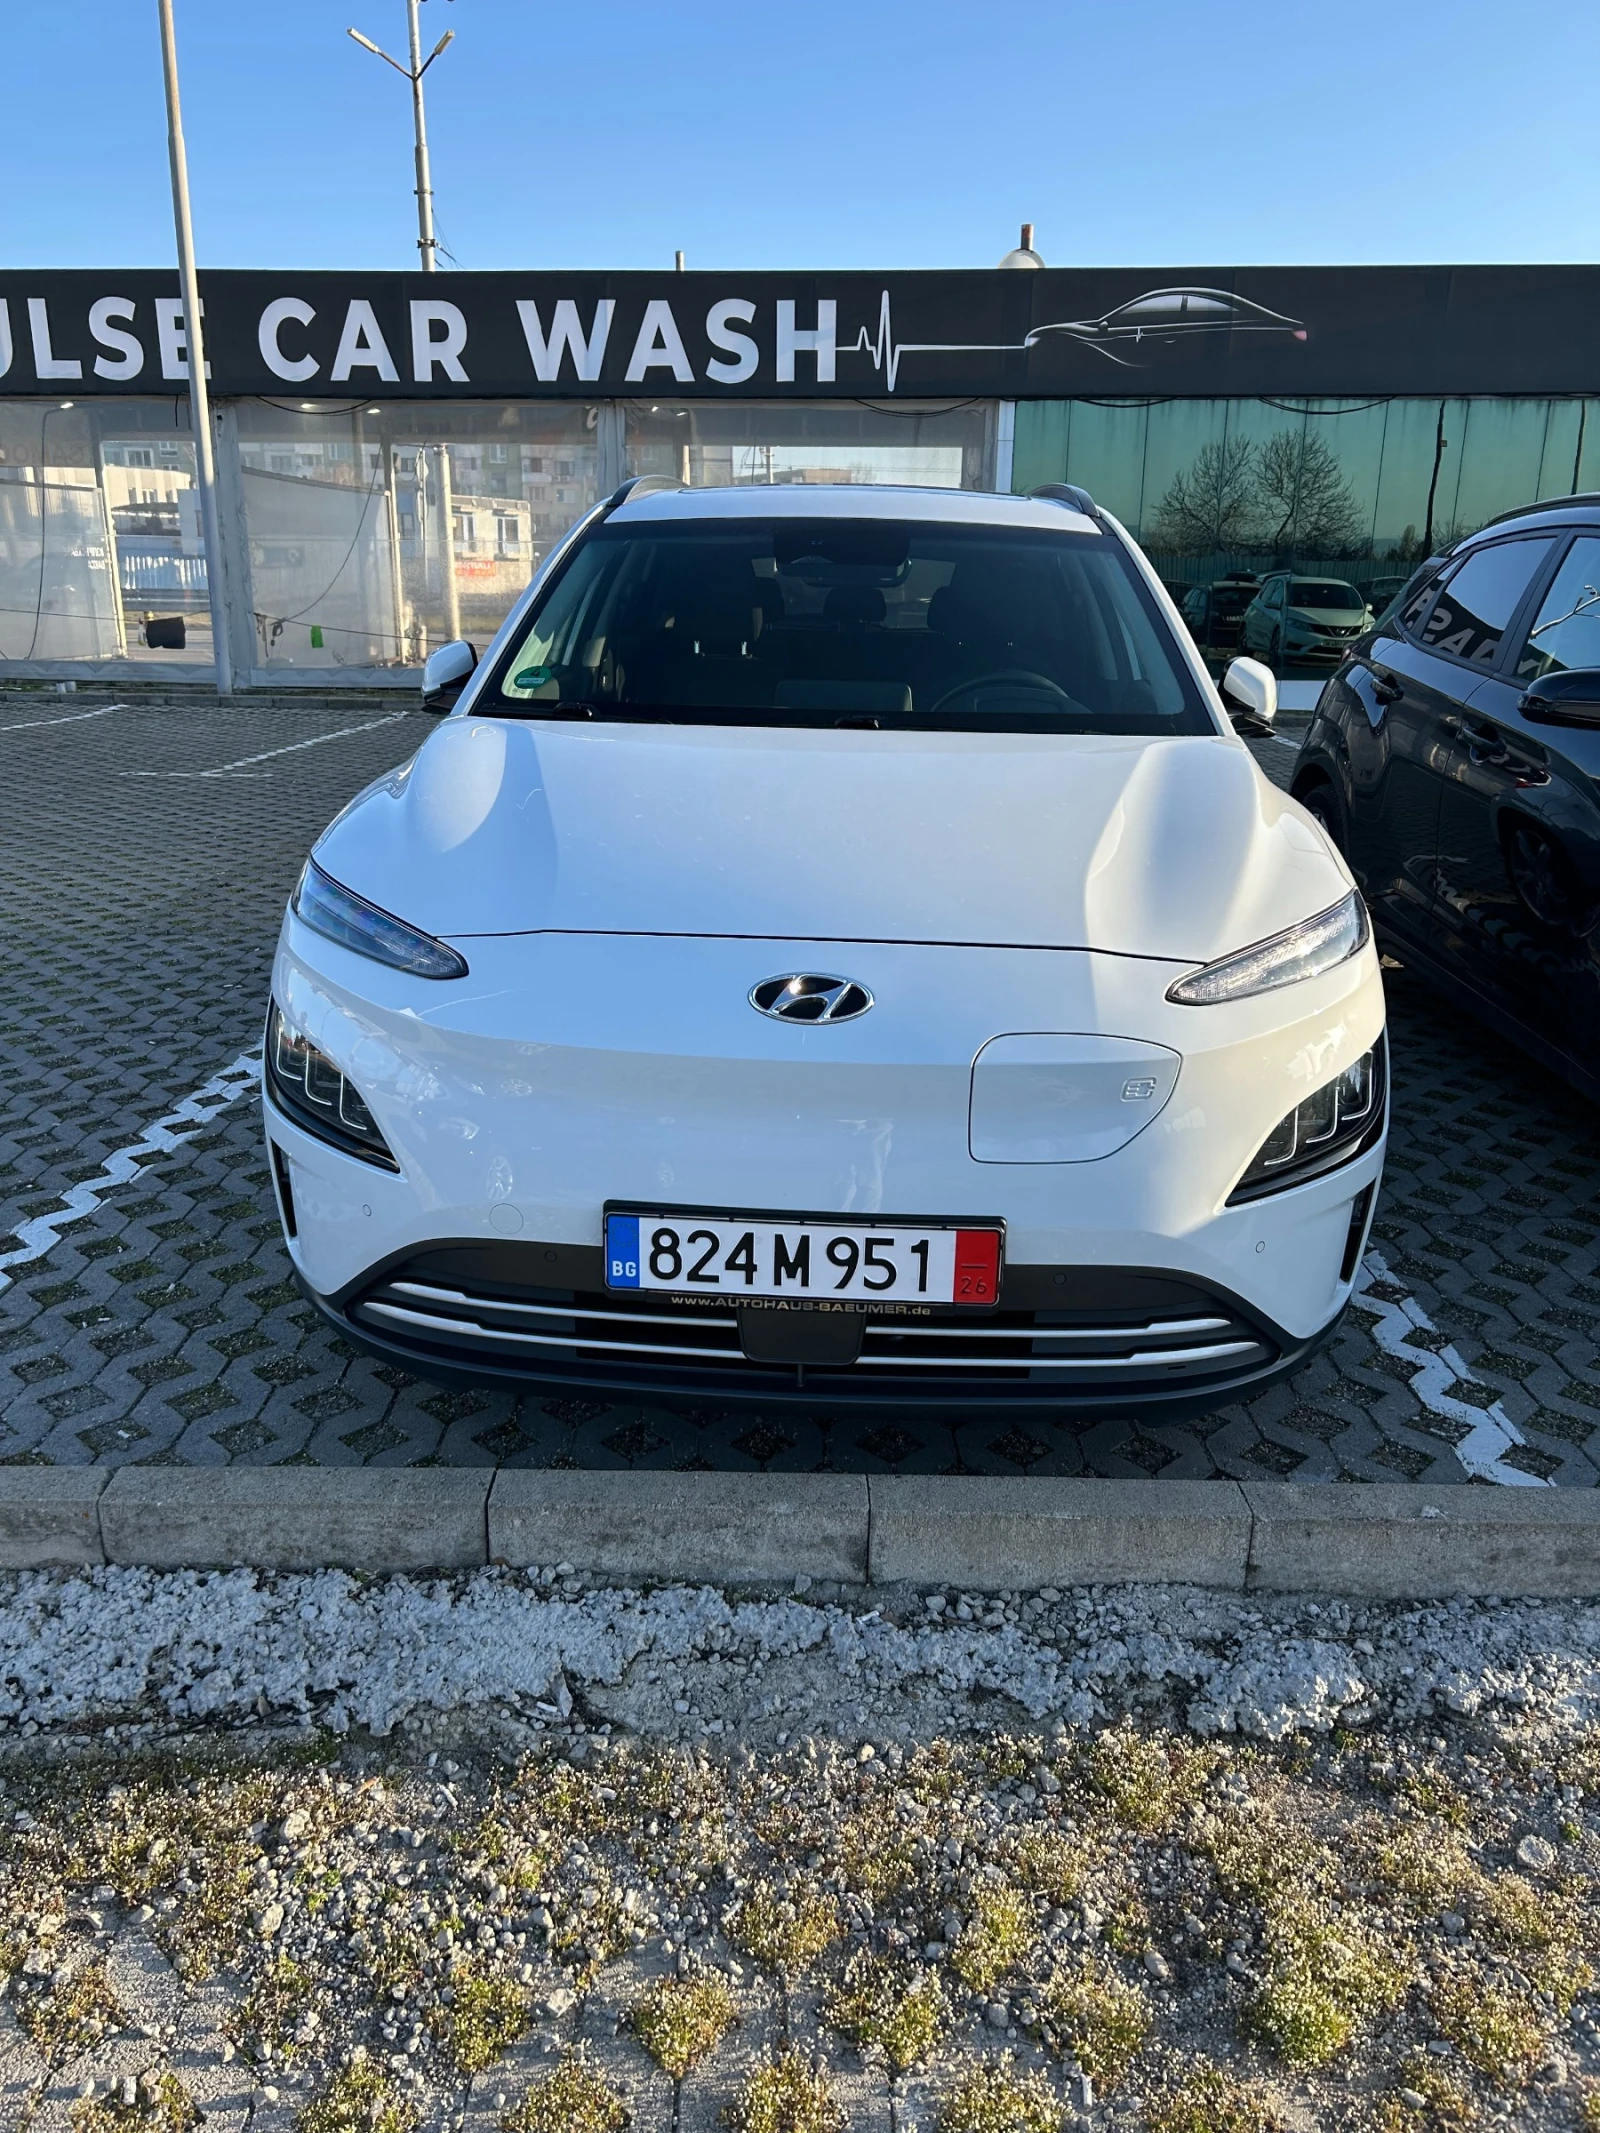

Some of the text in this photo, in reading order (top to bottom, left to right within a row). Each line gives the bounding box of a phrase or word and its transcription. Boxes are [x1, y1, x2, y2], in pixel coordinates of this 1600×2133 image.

[0, 296, 838, 384] LSE CAR WASH
[612, 1260, 637, 1277] BG
[960, 1276, 987, 1294] 26
[670, 1295, 931, 1316] www.AUTOHAUS-BAEUMER.de
